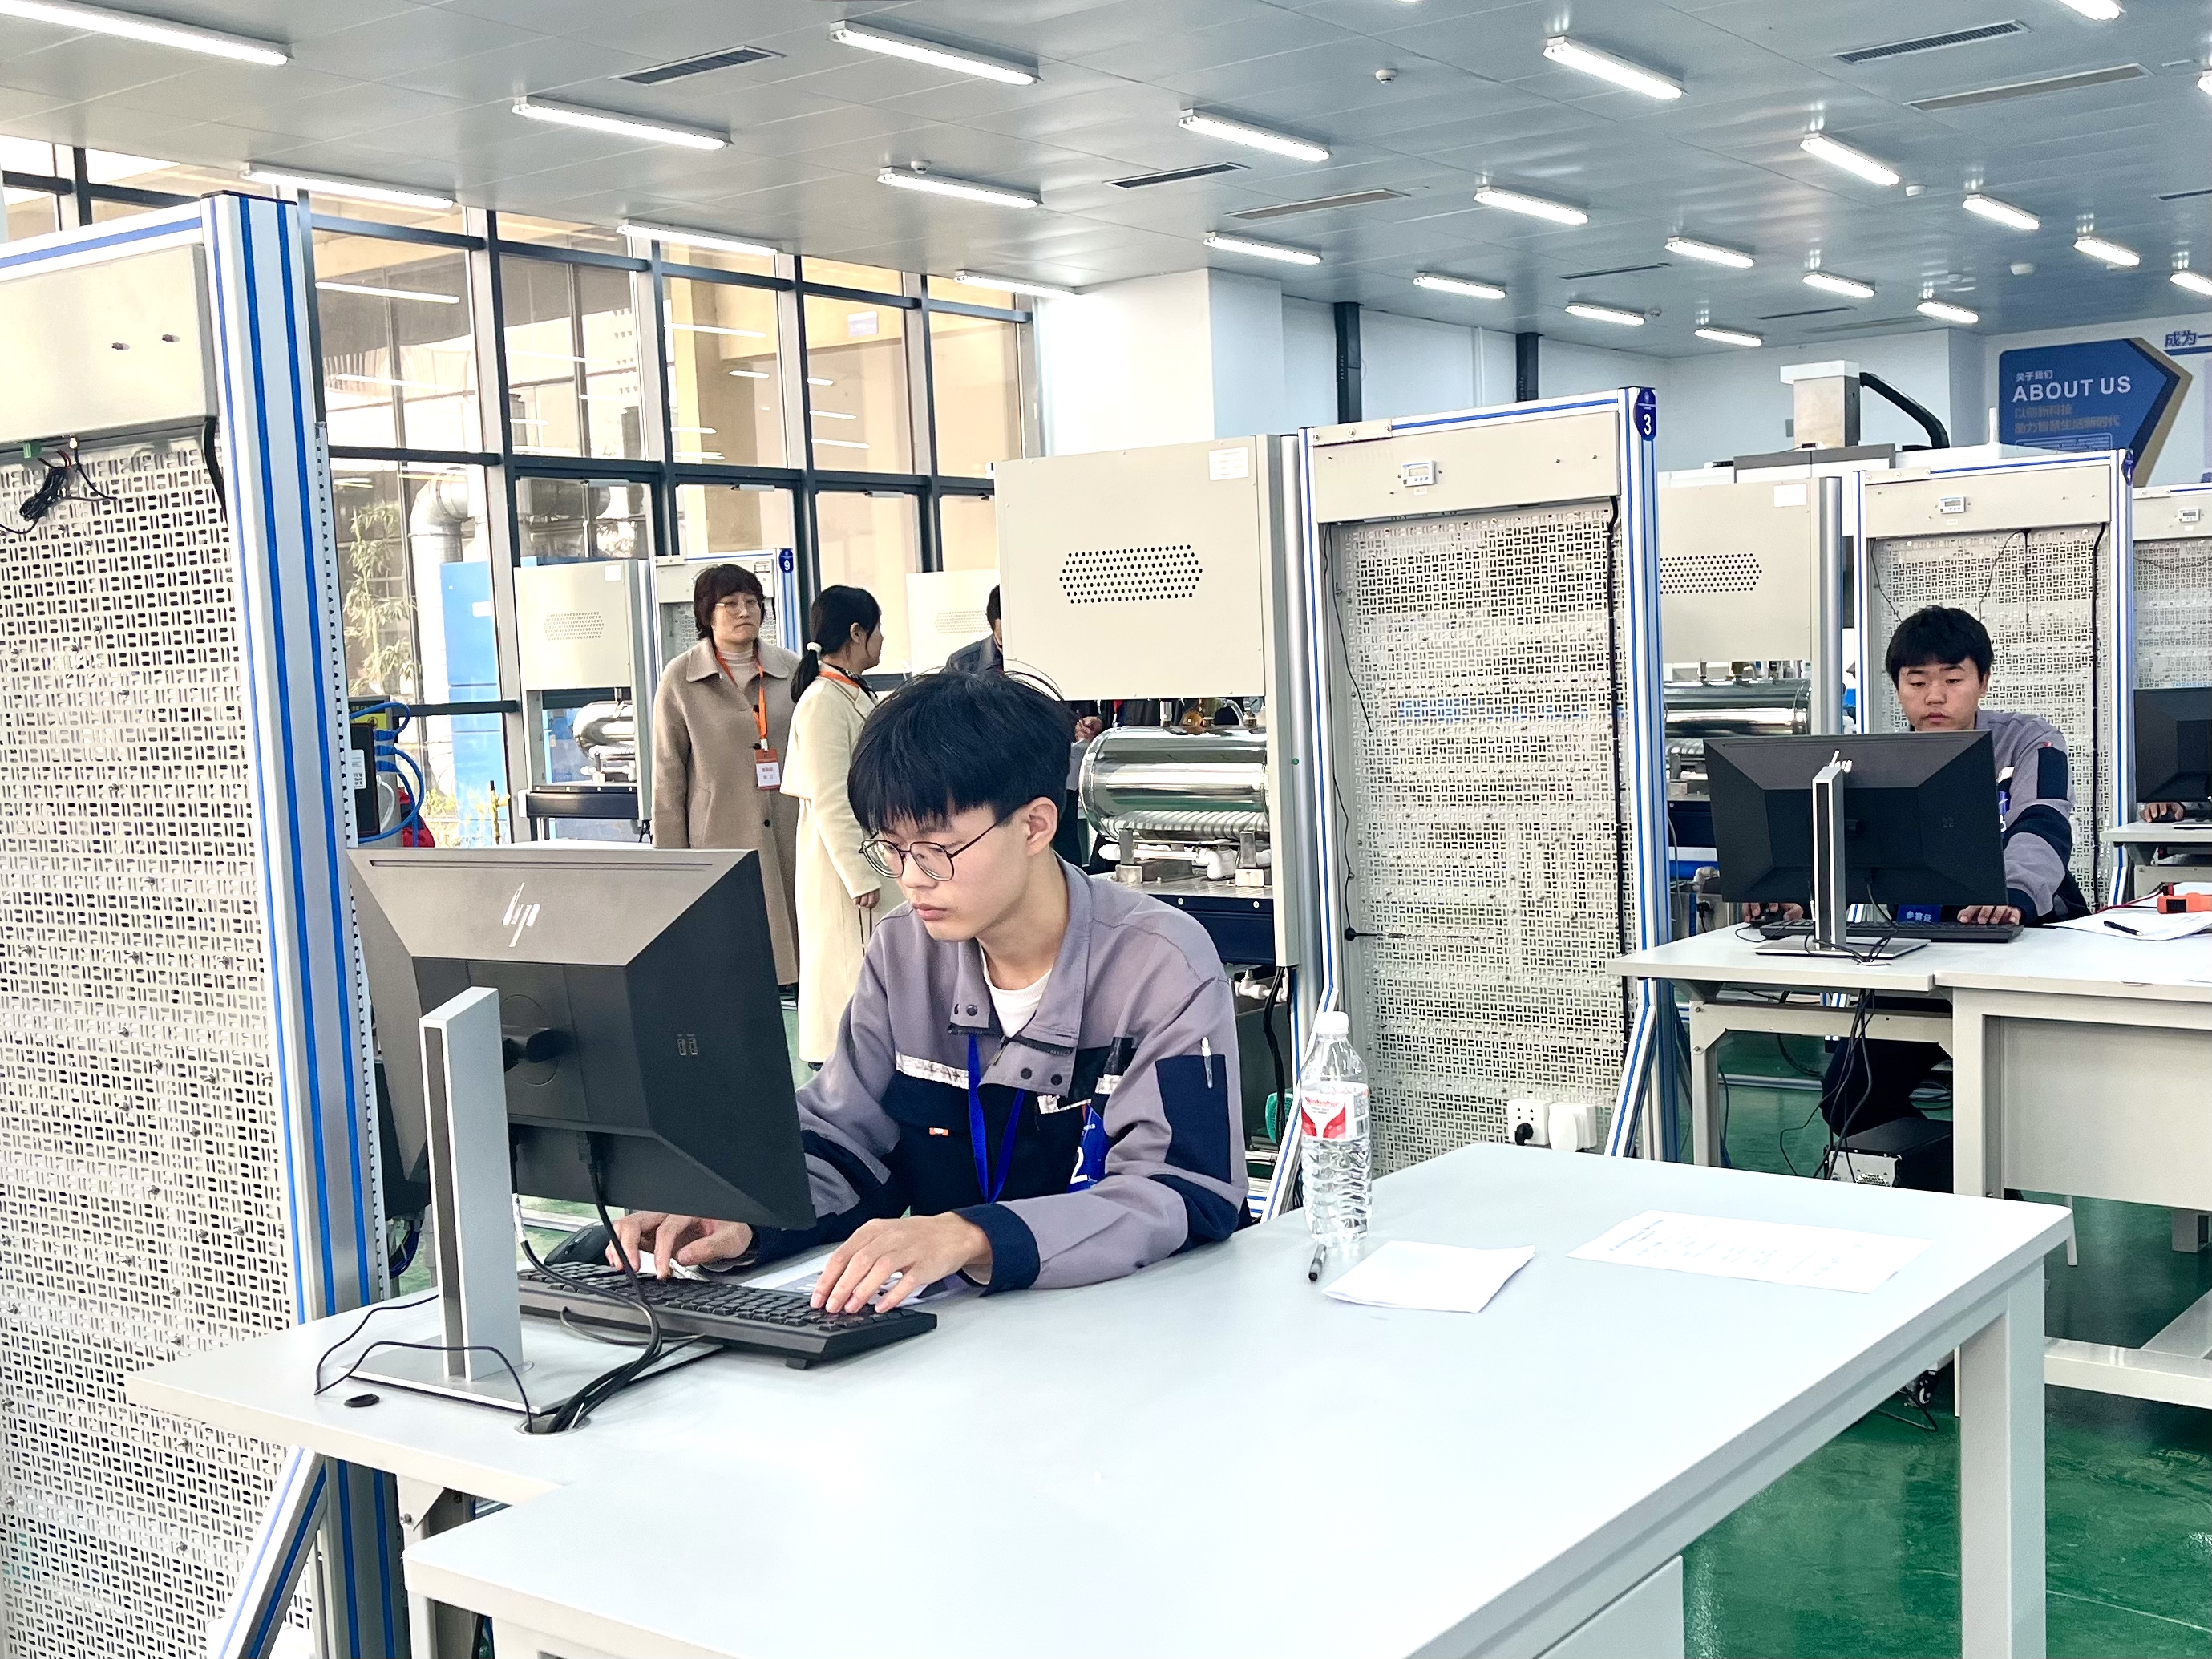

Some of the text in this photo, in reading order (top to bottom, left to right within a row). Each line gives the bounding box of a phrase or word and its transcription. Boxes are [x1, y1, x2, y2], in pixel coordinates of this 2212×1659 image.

[2016, 370, 2053, 382] 关于我们
[2012, 375, 2131, 402] ABOUT US
[1644, 414, 1652, 435] 3
[784, 560, 790, 570] 9
[502, 881, 540, 947] hp
